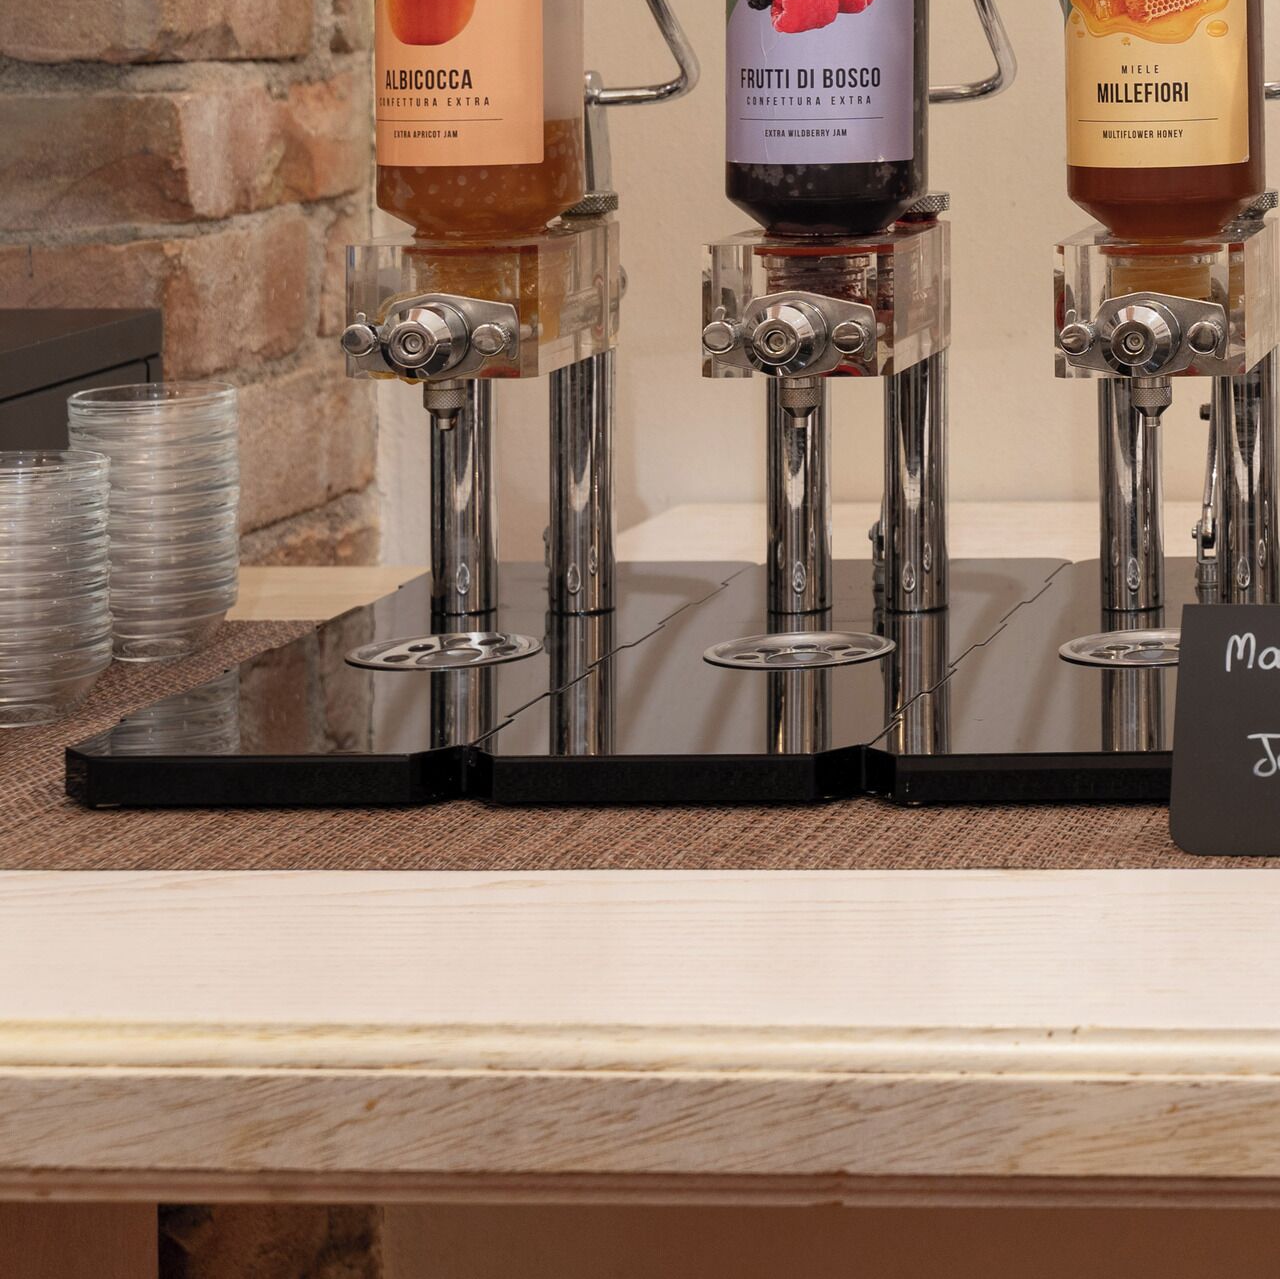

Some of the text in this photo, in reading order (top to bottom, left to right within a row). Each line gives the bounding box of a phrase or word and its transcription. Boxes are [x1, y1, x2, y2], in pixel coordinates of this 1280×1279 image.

[1121, 65, 1160, 74] MIELE
[385, 69, 473, 90] ALBICOCCA
[740, 67, 881, 89] FRUTTI DI BOSCO
[1097, 82, 1189, 103] MILLEFIORI
[447, 96, 490, 107] EXTRA
[746, 95, 872, 106] CONFETTURA EXTRA
[394, 130, 458, 138] EXTRA APRICOT JAM
[788, 129, 830, 137] WILDBERRY
[832, 129, 847, 137] JAM
[1102, 129, 1184, 139] MULTIFLOWER HONEY
